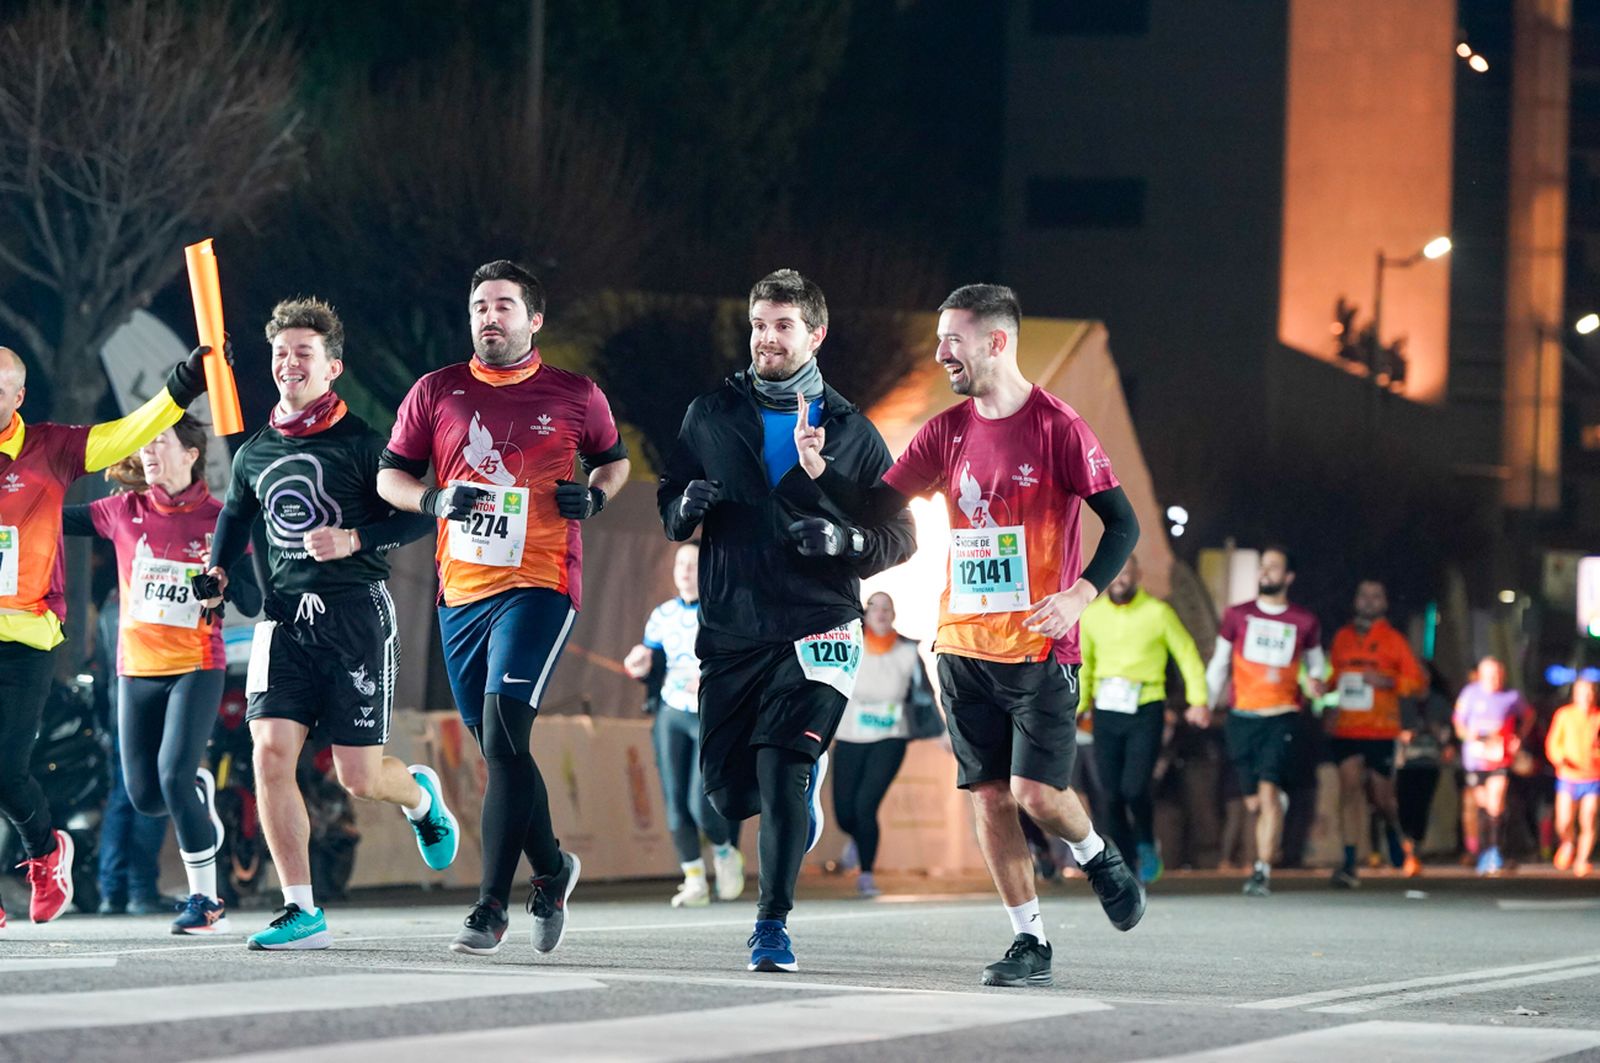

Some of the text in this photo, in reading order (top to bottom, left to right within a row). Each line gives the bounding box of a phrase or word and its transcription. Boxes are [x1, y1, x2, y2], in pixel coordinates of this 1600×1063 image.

[473, 501, 496, 512] NTÓN
[980, 539, 990, 547] DE
[960, 558, 1012, 585] 12141
[144, 581, 189, 604] 6443
